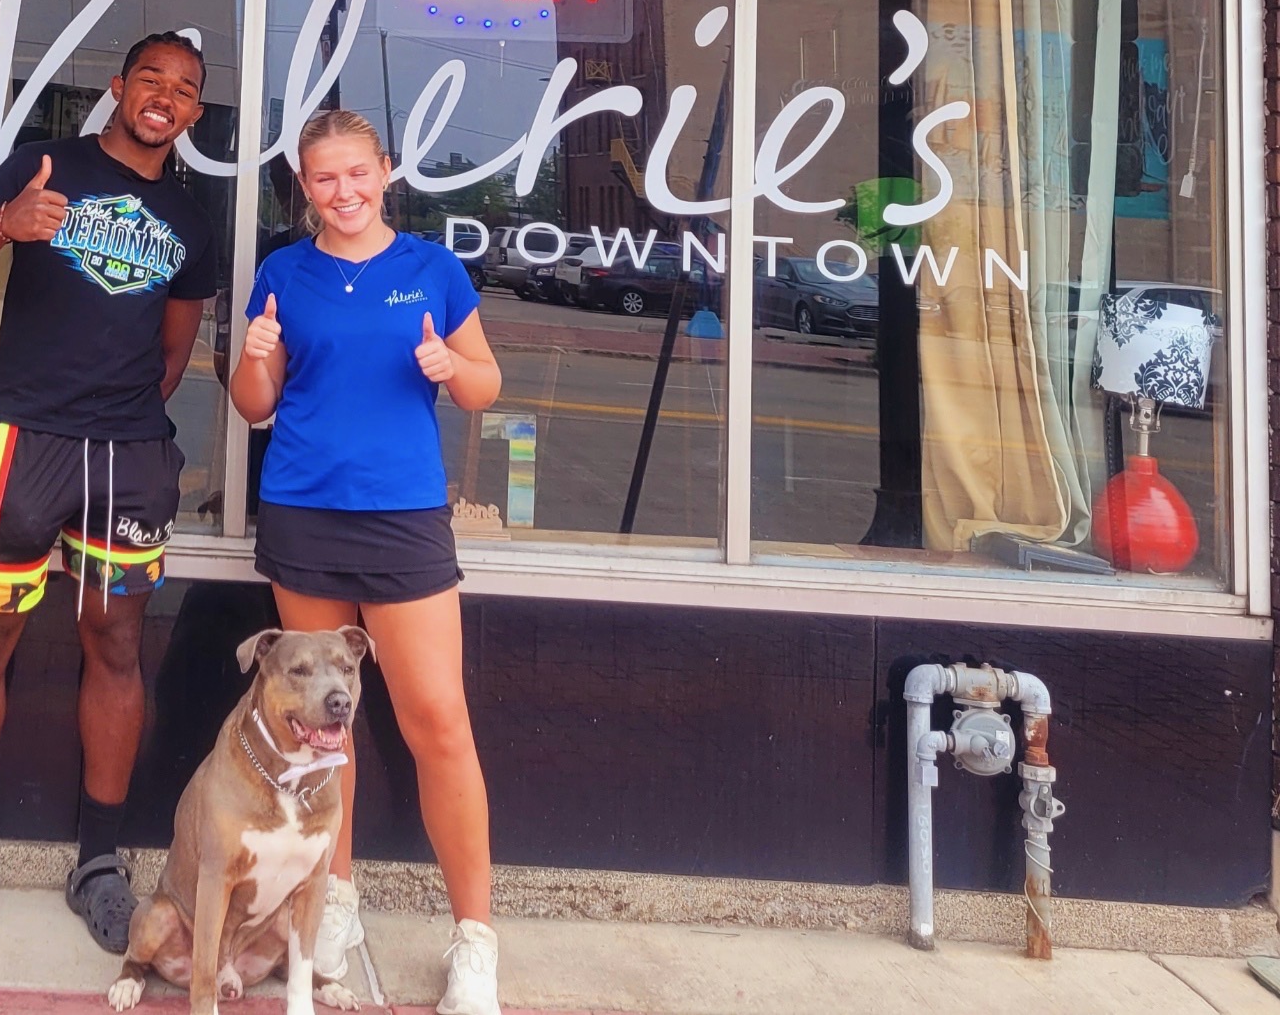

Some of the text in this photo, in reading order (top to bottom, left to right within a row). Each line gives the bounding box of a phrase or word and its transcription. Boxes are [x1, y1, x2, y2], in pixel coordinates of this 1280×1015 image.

[81, 198, 172, 240] Track and Field
[50, 206, 187, 282] REGIONALS
[445, 217, 1029, 290] DOWNTOWN
[91, 255, 103, 266] 20
[384, 289, 424, 307] Valerie's
[453, 497, 500, 519] done
[116, 516, 162, 543] Black
